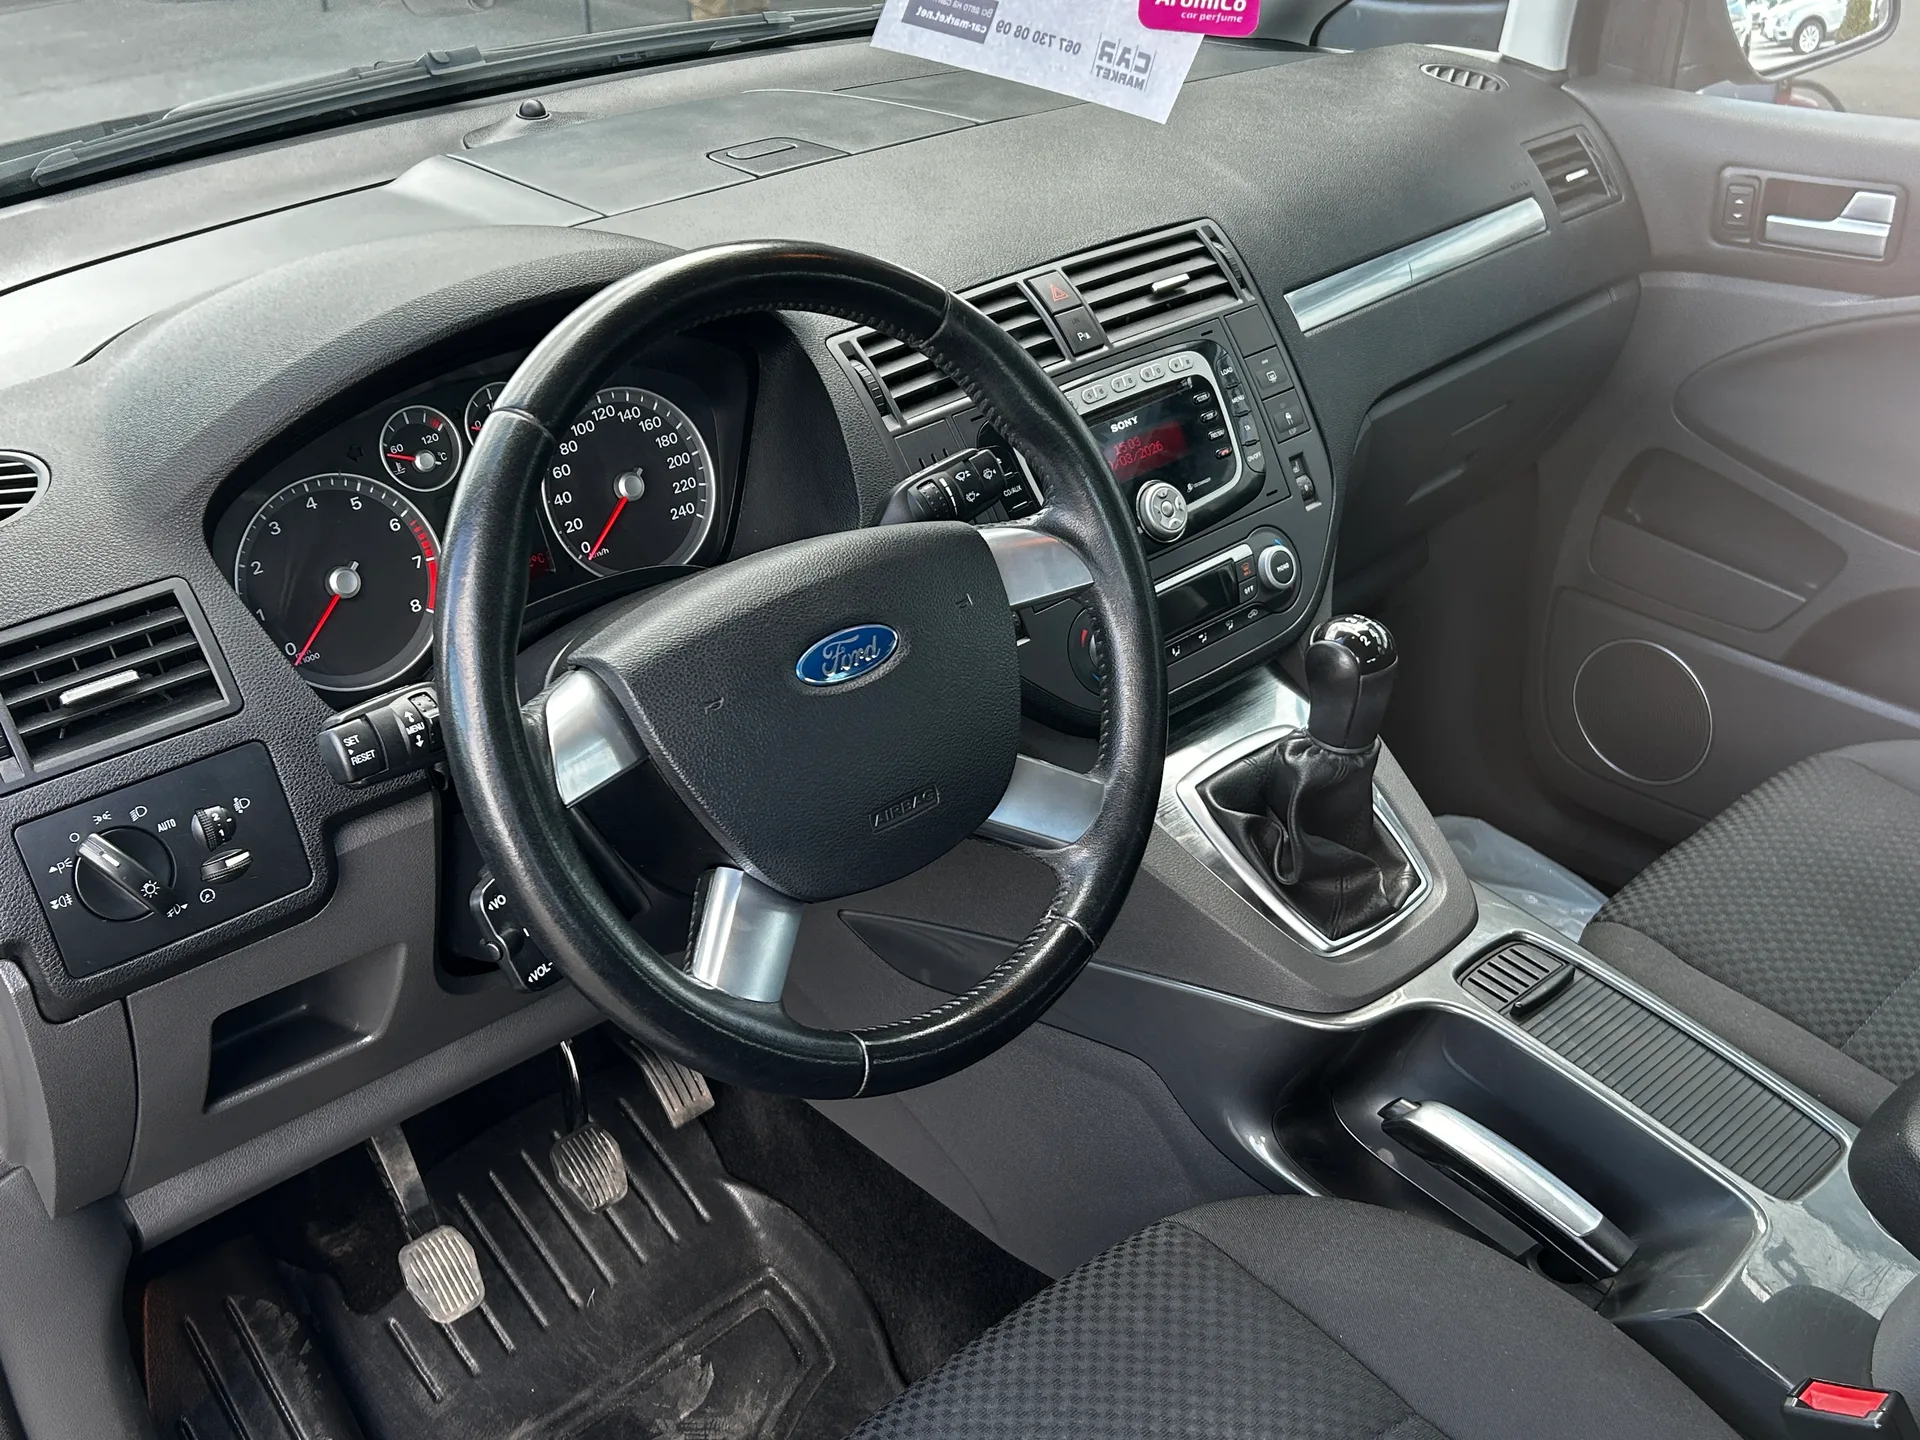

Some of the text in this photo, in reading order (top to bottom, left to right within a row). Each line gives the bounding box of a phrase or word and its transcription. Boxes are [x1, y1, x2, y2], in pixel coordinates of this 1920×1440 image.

[1181, 11, 1243, 23] car perfume
[1220, 366, 1234, 376] LOAD
[591, 405, 615, 421] 120
[617, 406, 641, 423] 140
[570, 419, 595, 437] 100
[638, 416, 662, 432] 160
[1110, 416, 1138, 433] SONY
[421, 433, 439, 445] 120
[655, 432, 678, 449] 180
[390, 443, 404, 454] 60
[559, 440, 578, 456] 80
[667, 452, 691, 470] 200
[552, 463, 571, 479] 60
[672, 477, 696, 494] 220
[305, 496, 318, 510] 4
[350, 497, 363, 511] 5
[554, 491, 572, 506] 40
[670, 502, 695, 521] 240
[268, 521, 282, 535] 3
[389, 518, 401, 532] 6
[564, 518, 583, 534] 20
[581, 541, 591, 554] 0
[250, 560, 264, 575] 2
[411, 555, 422, 569] 7
[410, 599, 422, 613] 8
[255, 608, 266, 621] 1
[1360, 635, 1371, 646] 2
[284, 642, 297, 656] 0
[822, 635, 880, 676] Ford
[405, 721, 426, 735] MENU
[343, 734, 360, 747] SET
[350, 749, 376, 766] RESET
[874, 788, 935, 827] AIRBAG
[211, 812, 220, 822] 2
[157, 818, 177, 833] AUTO
